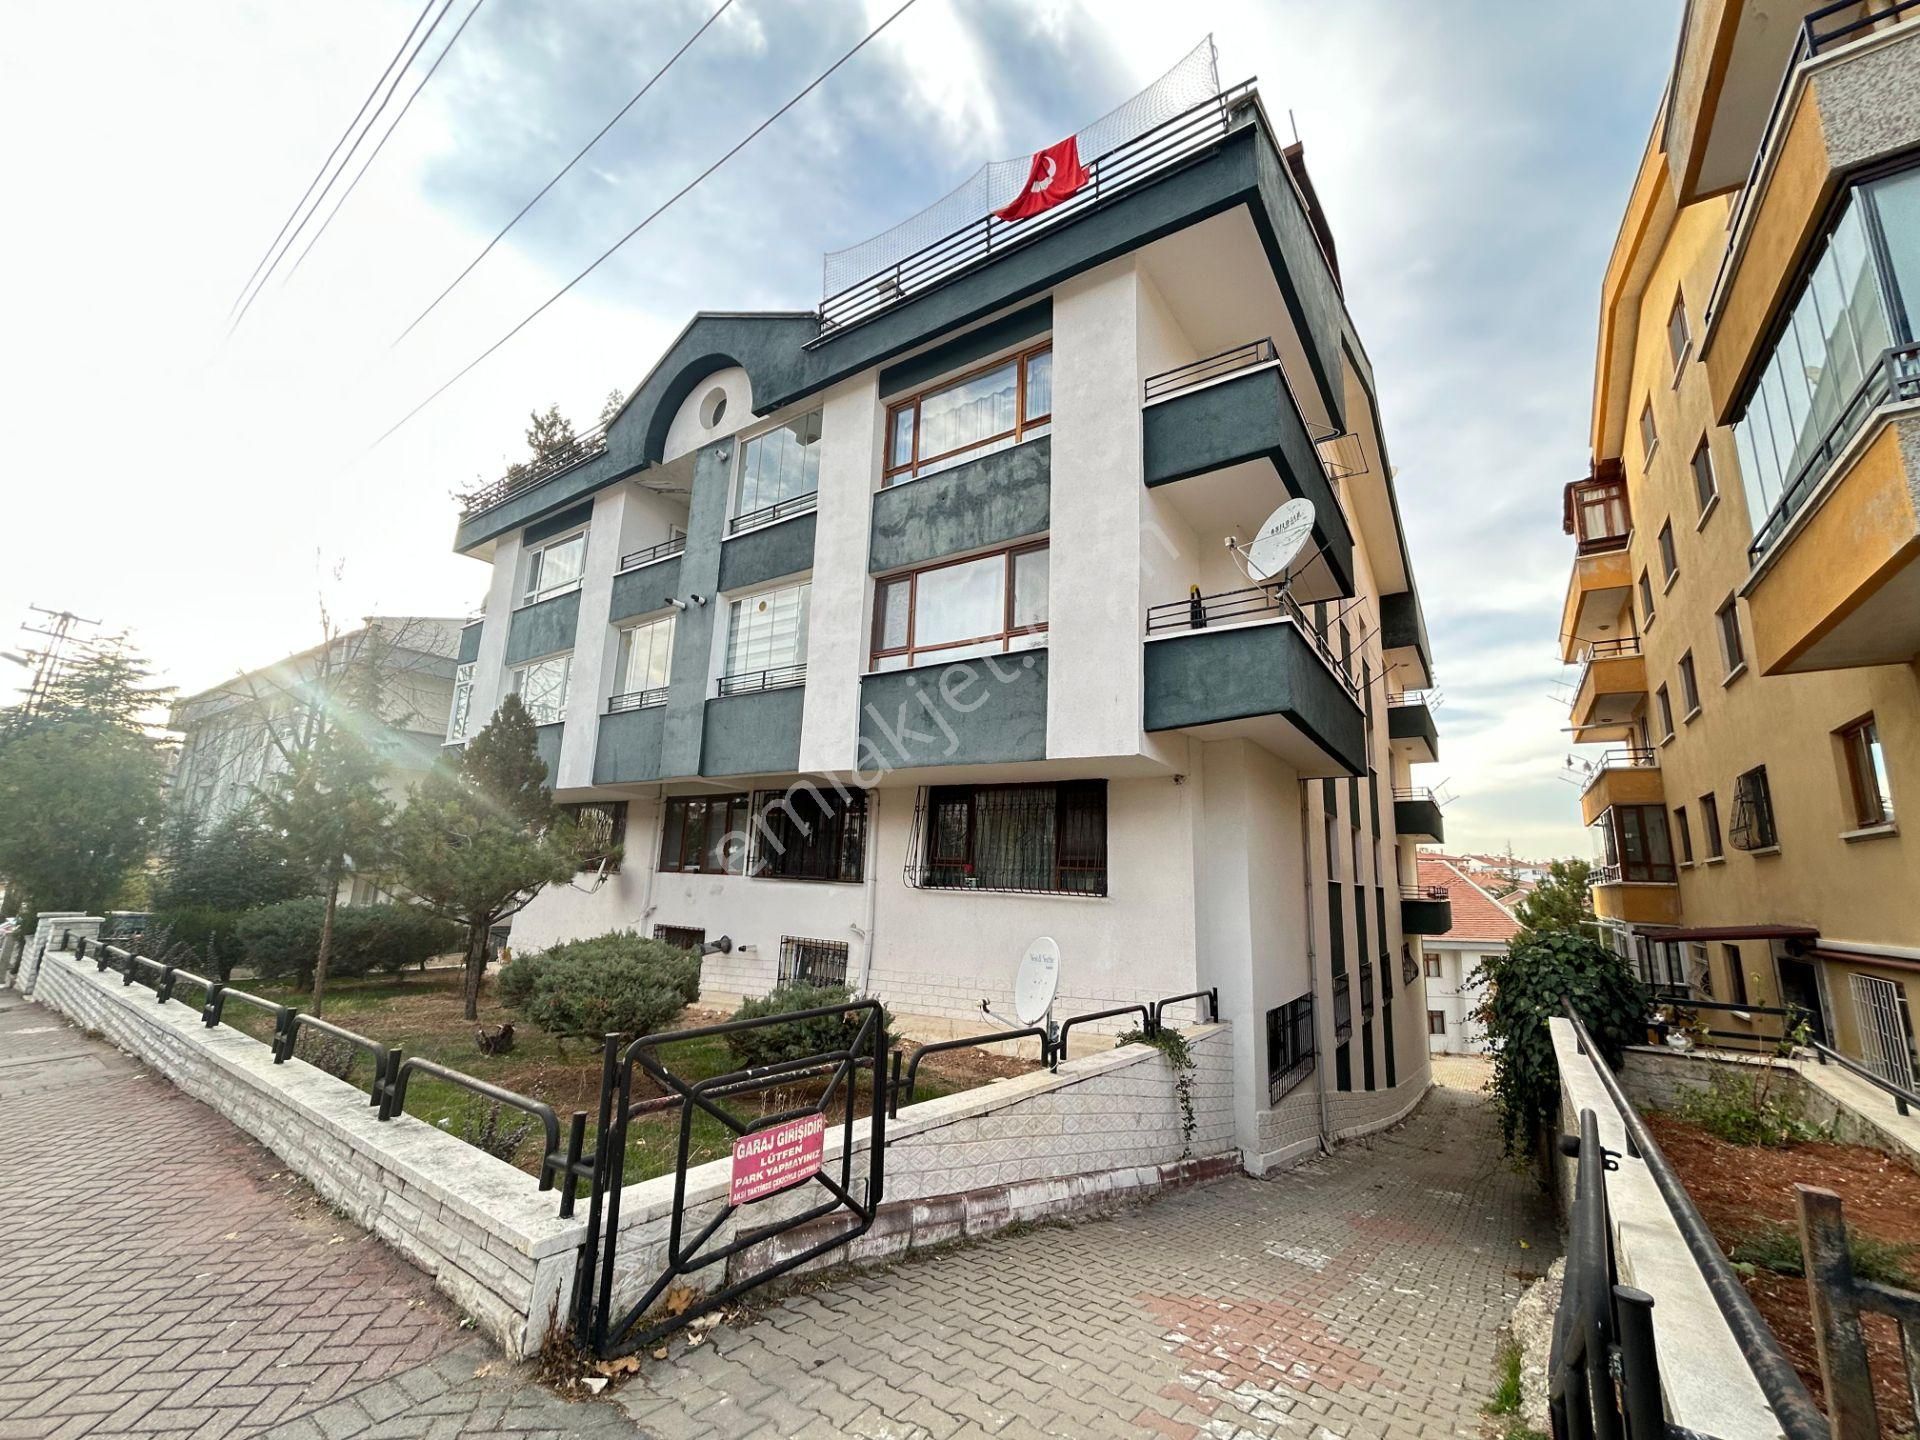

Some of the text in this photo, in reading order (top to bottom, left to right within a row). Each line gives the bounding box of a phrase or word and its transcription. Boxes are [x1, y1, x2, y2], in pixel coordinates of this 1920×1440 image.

[737, 1135, 774, 1160] GARAJ
[760, 1144, 803, 1167] LÜTFEN
[735, 1149, 820, 1188] PARK YAPMAYINIZ
